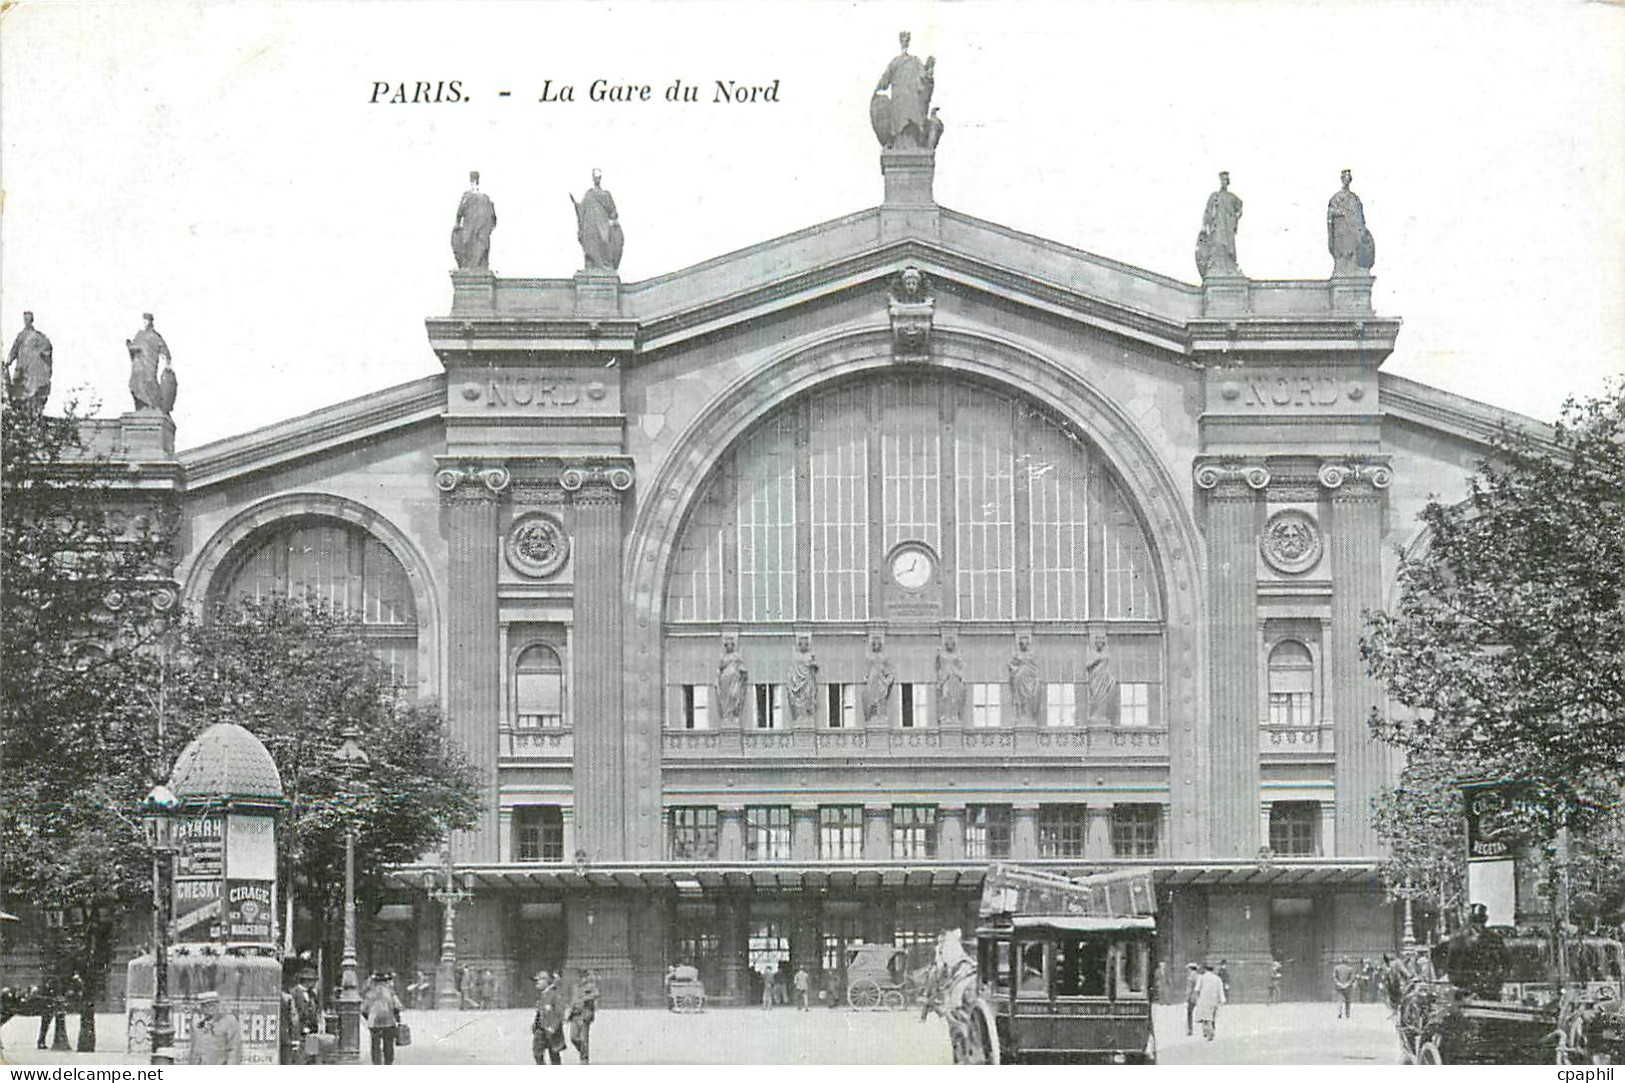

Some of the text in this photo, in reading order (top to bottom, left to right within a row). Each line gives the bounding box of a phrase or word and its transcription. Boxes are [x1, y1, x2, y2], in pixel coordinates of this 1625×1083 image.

[486, 376, 580, 407] NORD
[1245, 376, 1339, 407] NORD
[229, 886, 271, 904] CIRAGE
